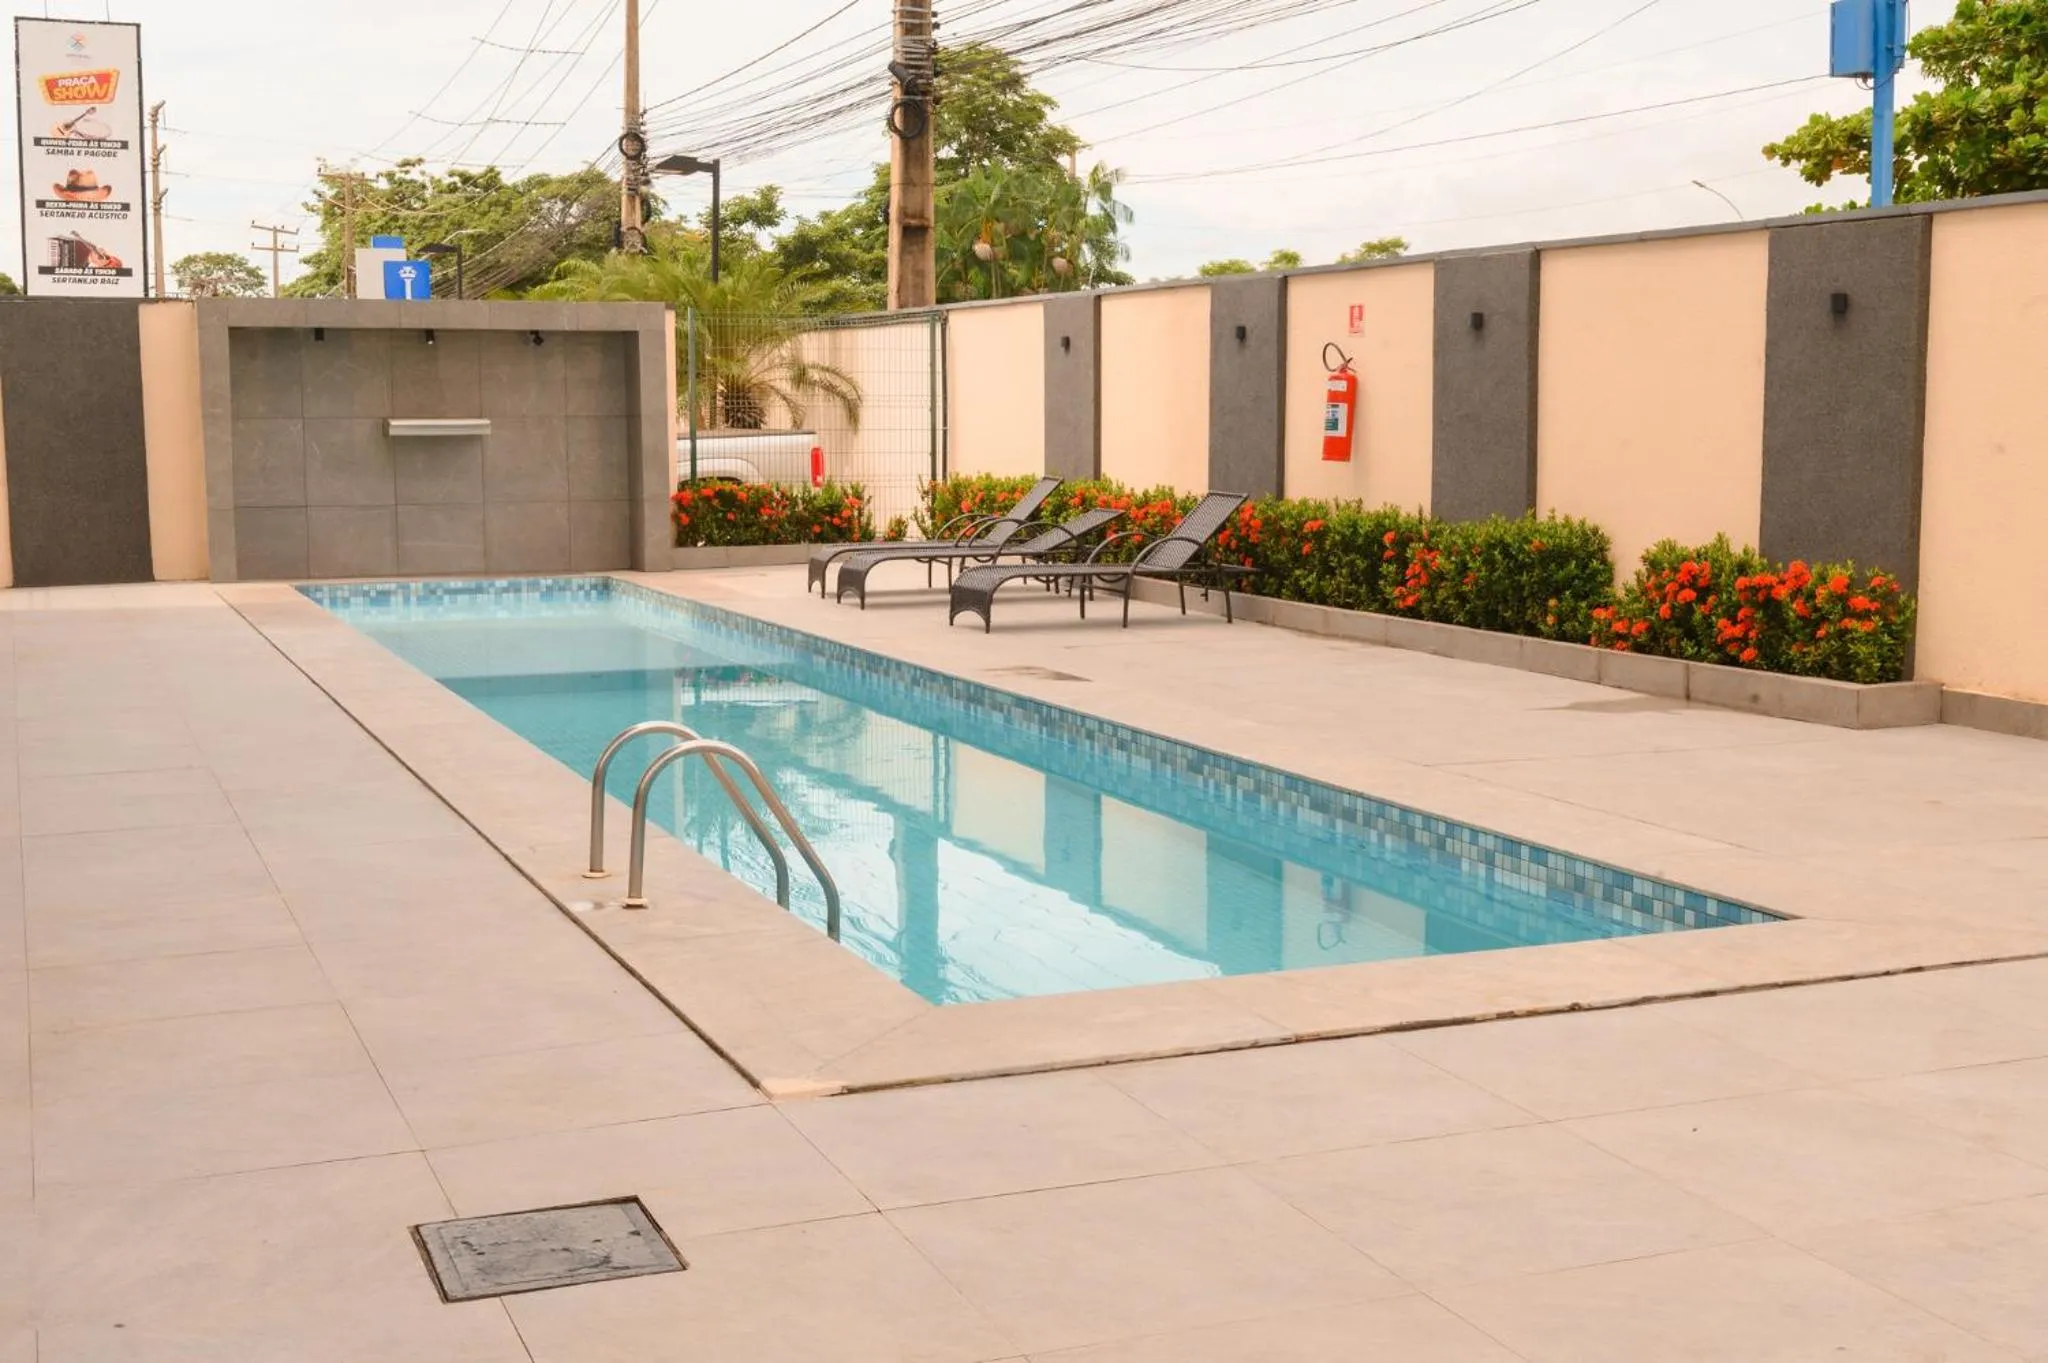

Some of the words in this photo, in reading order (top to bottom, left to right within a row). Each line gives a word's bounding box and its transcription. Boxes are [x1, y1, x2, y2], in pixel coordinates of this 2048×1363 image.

[53, 85, 107, 99] SHOW
[45, 148, 75, 156] SAMBA
[40, 210, 87, 219] SERTANEJO
[52, 276, 98, 285] SERTANEJO
